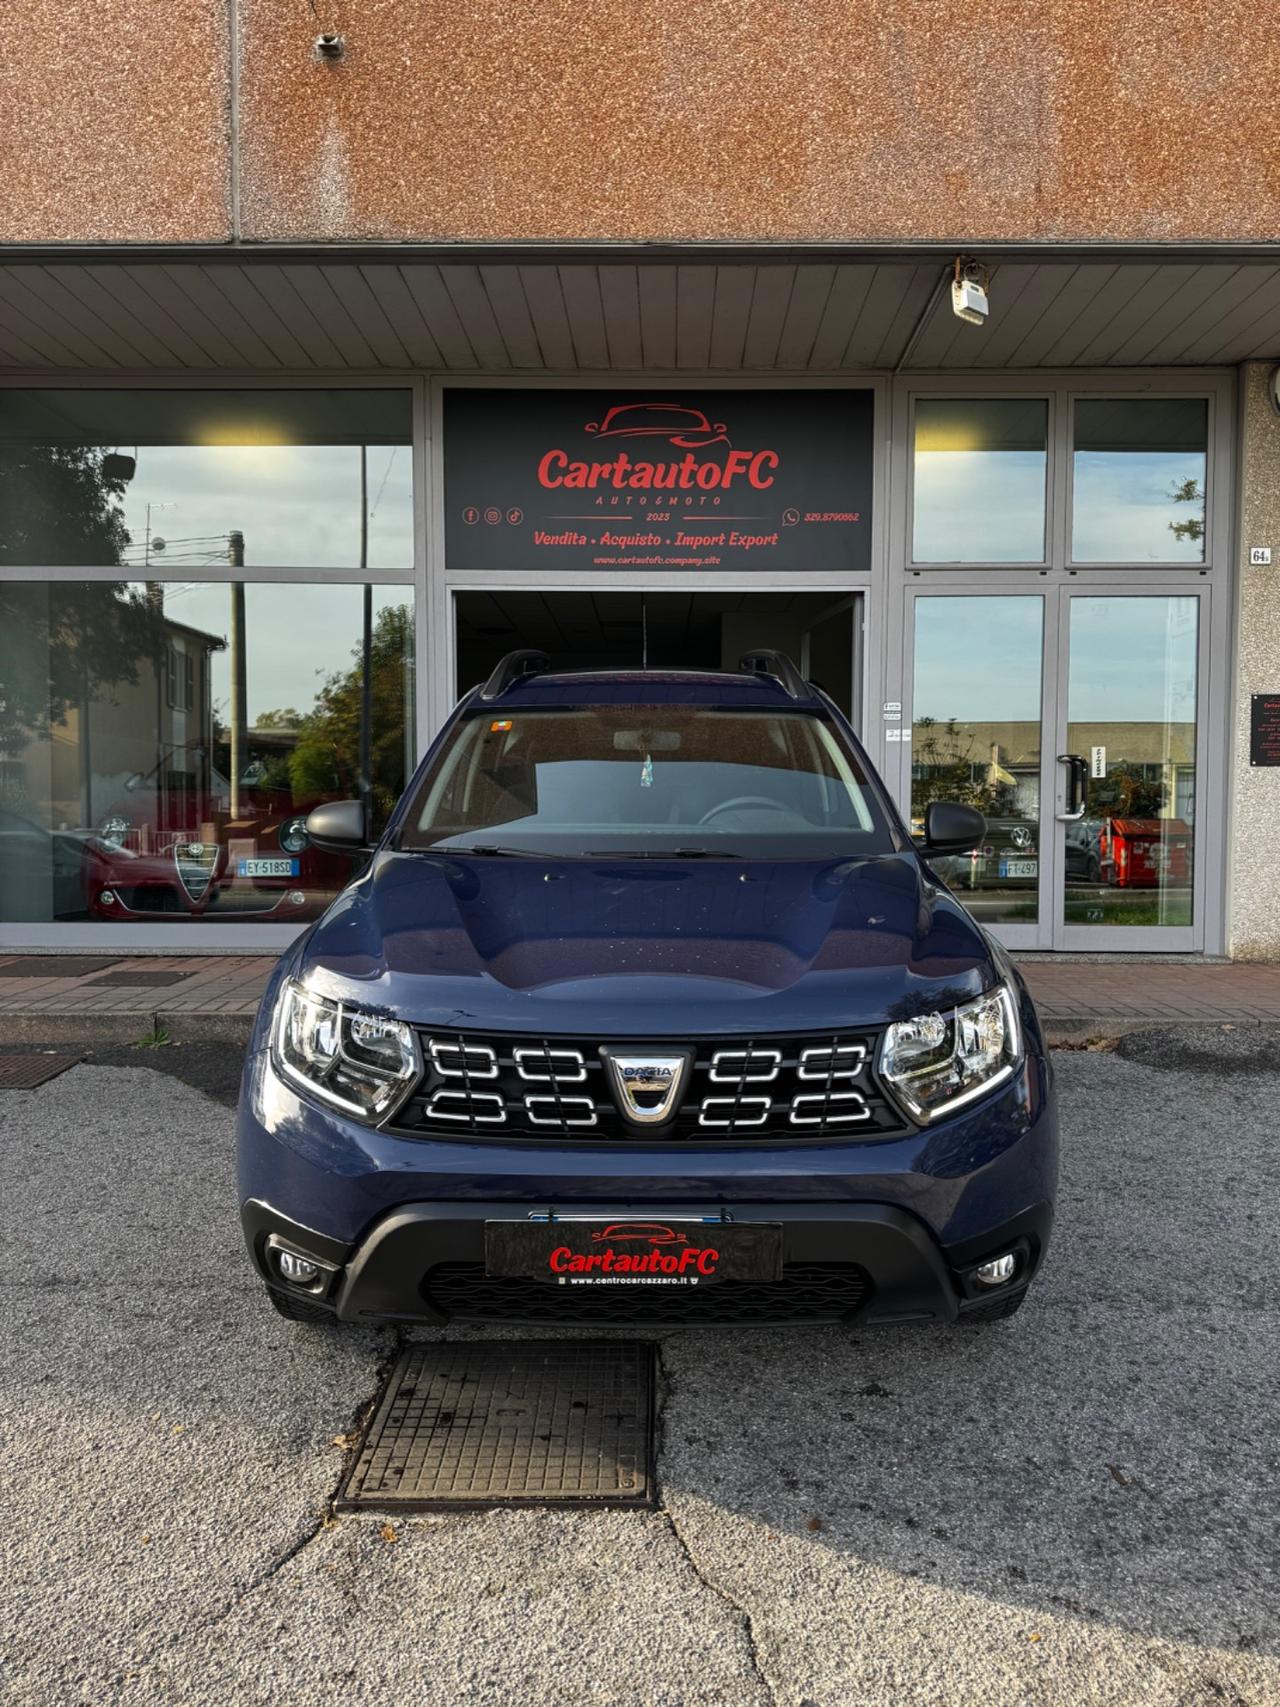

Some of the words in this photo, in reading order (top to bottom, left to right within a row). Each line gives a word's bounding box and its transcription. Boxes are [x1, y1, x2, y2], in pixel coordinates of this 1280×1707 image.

[537, 449, 779, 490] CartautoFC
[533, 531, 587, 546] Vendita
[600, 531, 661, 549] Acquisto
[674, 531, 725, 549] Import
[728, 531, 778, 549] Export
[623, 1066, 672, 1076] DACIA
[550, 1246, 719, 1275] CartautoFC
